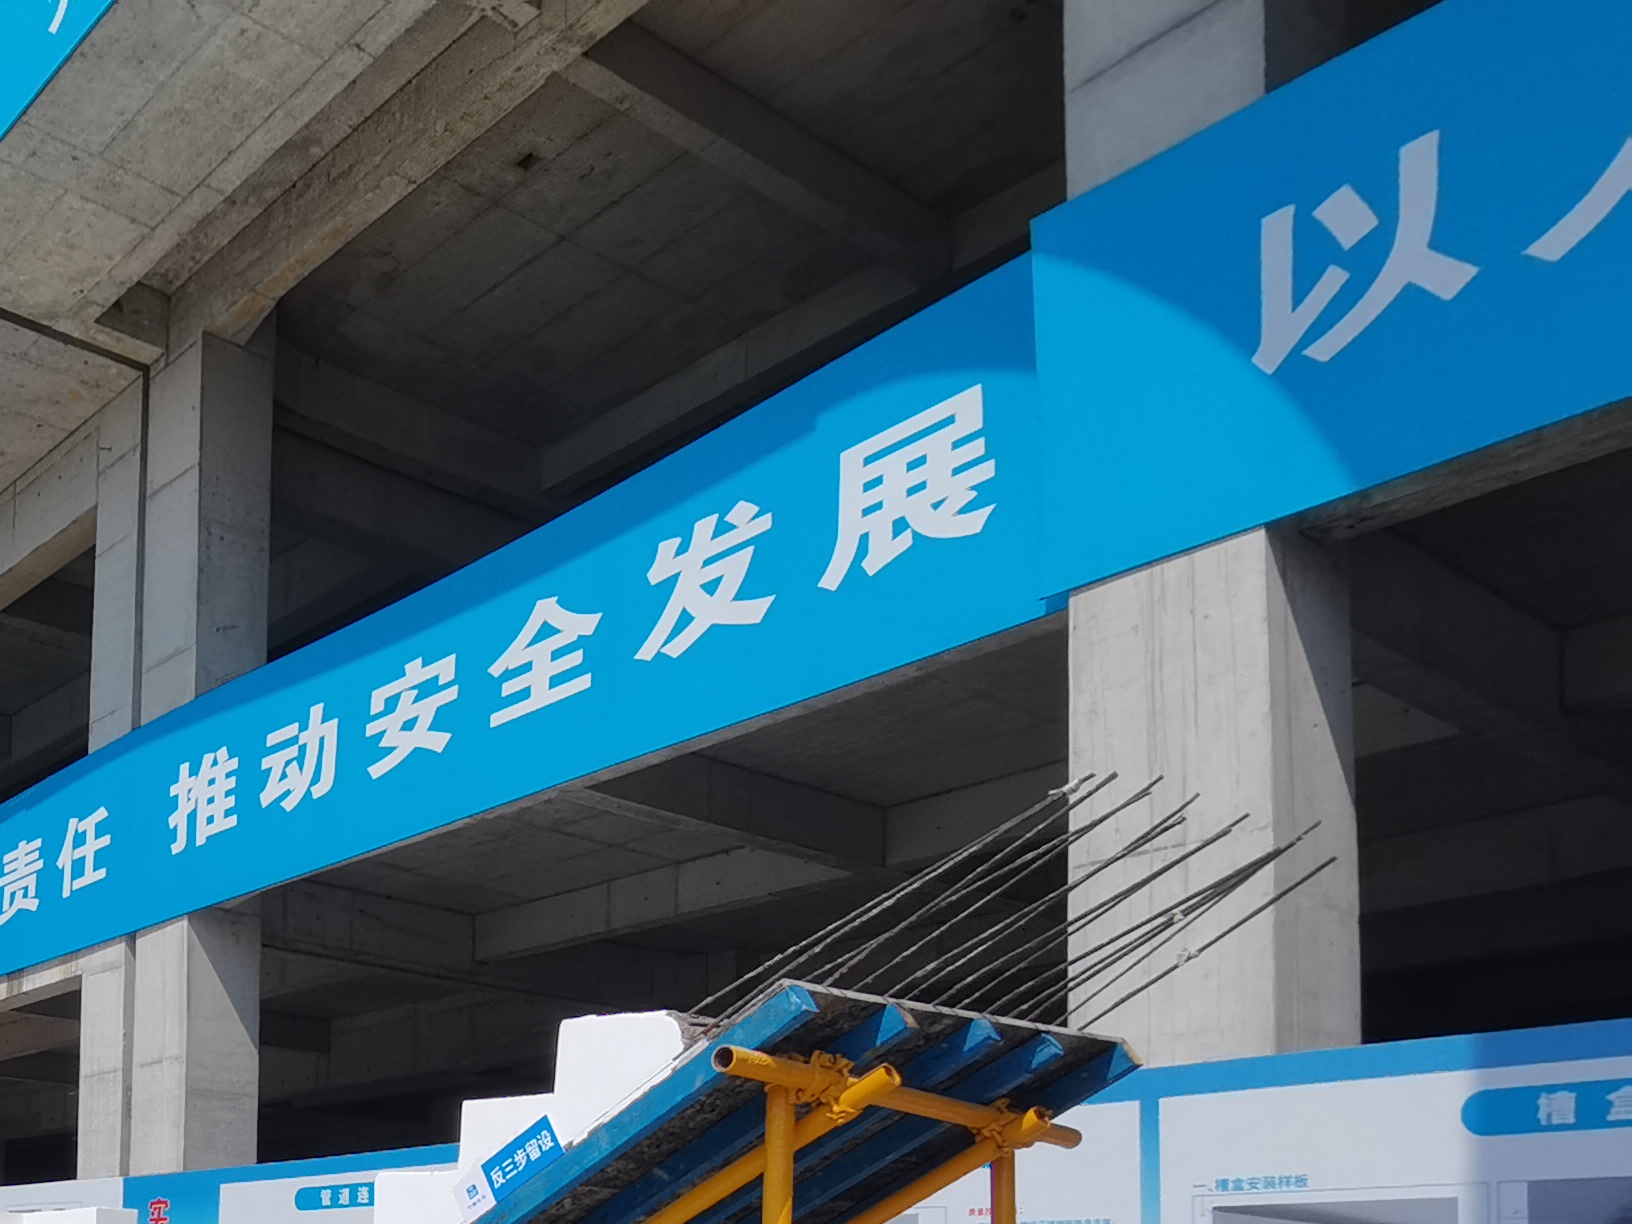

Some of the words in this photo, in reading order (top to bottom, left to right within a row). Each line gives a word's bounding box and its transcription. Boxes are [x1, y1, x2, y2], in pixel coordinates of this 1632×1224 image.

[168, 384, 997, 854] 推动安全发展
[489, 1130, 556, 1190] 反三步留设
